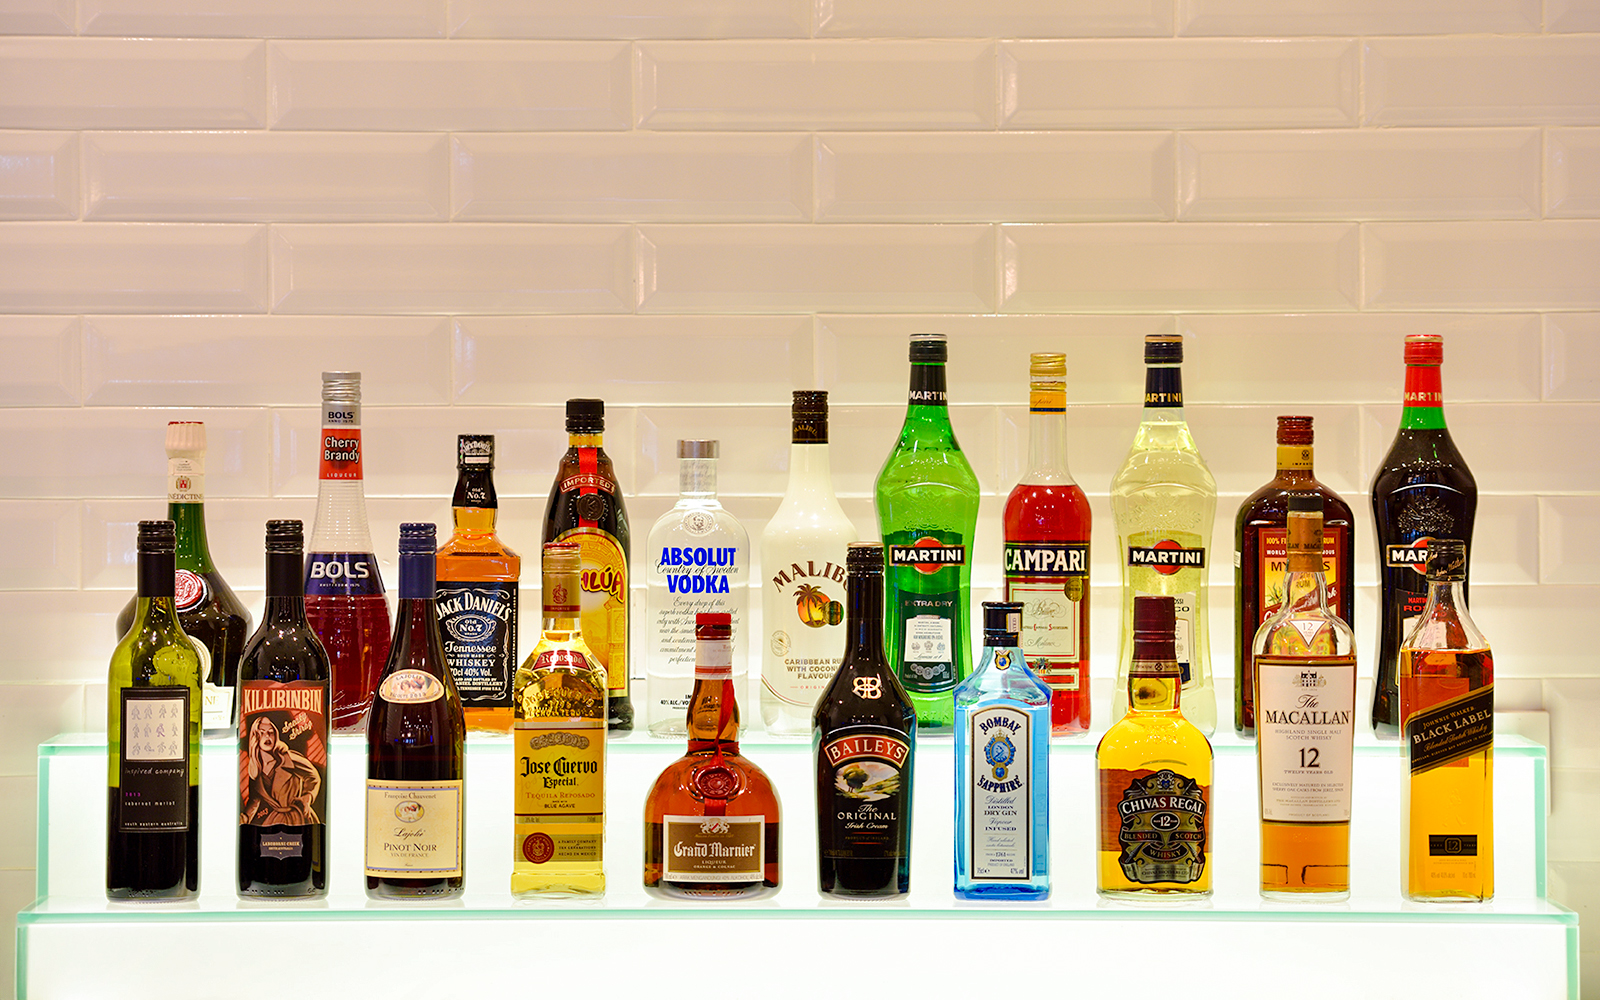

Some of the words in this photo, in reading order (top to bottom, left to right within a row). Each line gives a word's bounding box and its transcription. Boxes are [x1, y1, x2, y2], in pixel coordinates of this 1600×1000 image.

[1145, 392, 1182, 402] ARTINI
[328, 411, 354, 419] BOLS
[794, 425, 818, 437] MALIBU
[324, 436, 360, 450] Cherry
[324, 450, 360, 464] Brandy
[564, 477, 611, 489] IMPORTED
[660, 547, 737, 566] ABSOLUT
[894, 550, 962, 562] MARTINI
[1004, 548, 1086, 572] CAMPARI
[1132, 550, 1200, 564] MARTINI
[310, 561, 370, 579] BOLS
[654, 559, 692, 580] Country
[704, 563, 739, 575] Sweden
[666, 574, 730, 594] VODKA
[435, 597, 463, 620] JACK
[465, 592, 512, 621] DANIEL'S
[673, 596, 694, 607] Every
[460, 624, 482, 632] No.7
[1302, 622, 1314, 631] 12
[445, 641, 497, 653] Tennessee
[447, 659, 496, 667] WHISKEY
[464, 668, 479, 676] 40%
[480, 668, 492, 676] Vol.
[244, 689, 322, 715] KILLIBINBIN
[1294, 694, 1319, 709] The
[1264, 710, 1349, 724] MACALLAN
[1422, 714, 1450, 730] JOHNNIE
[1450, 706, 1474, 718] WALKER
[980, 717, 1021, 735] BOMBAY
[1412, 722, 1452, 744] BLACK
[1454, 710, 1491, 730] LABEL
[830, 739, 905, 760] BAILEYS
[1424, 739, 1448, 752] Blended
[1298, 747, 1320, 768] 12
[125, 767, 153, 776] inspired
[154, 768, 184, 778] company
[520, 756, 551, 778] Jose
[553, 756, 598, 777] Cuervo
[977, 775, 1022, 793] SAPPHIRE
[525, 792, 558, 800] TEQUILA
[985, 795, 1016, 804] Distilled
[858, 804, 878, 813] The
[1122, 797, 1167, 814] CHIVAS
[1170, 796, 1203, 815] REGAL
[837, 812, 897, 820] ORIGINAL
[1160, 816, 1170, 826] 12
[384, 842, 411, 851] PINOT
[413, 843, 437, 851] NOIR
[674, 841, 708, 858] Grand
[709, 842, 756, 858] Marnier
[1448, 841, 1458, 850] 12
[1150, 849, 1182, 858] WHISKY
